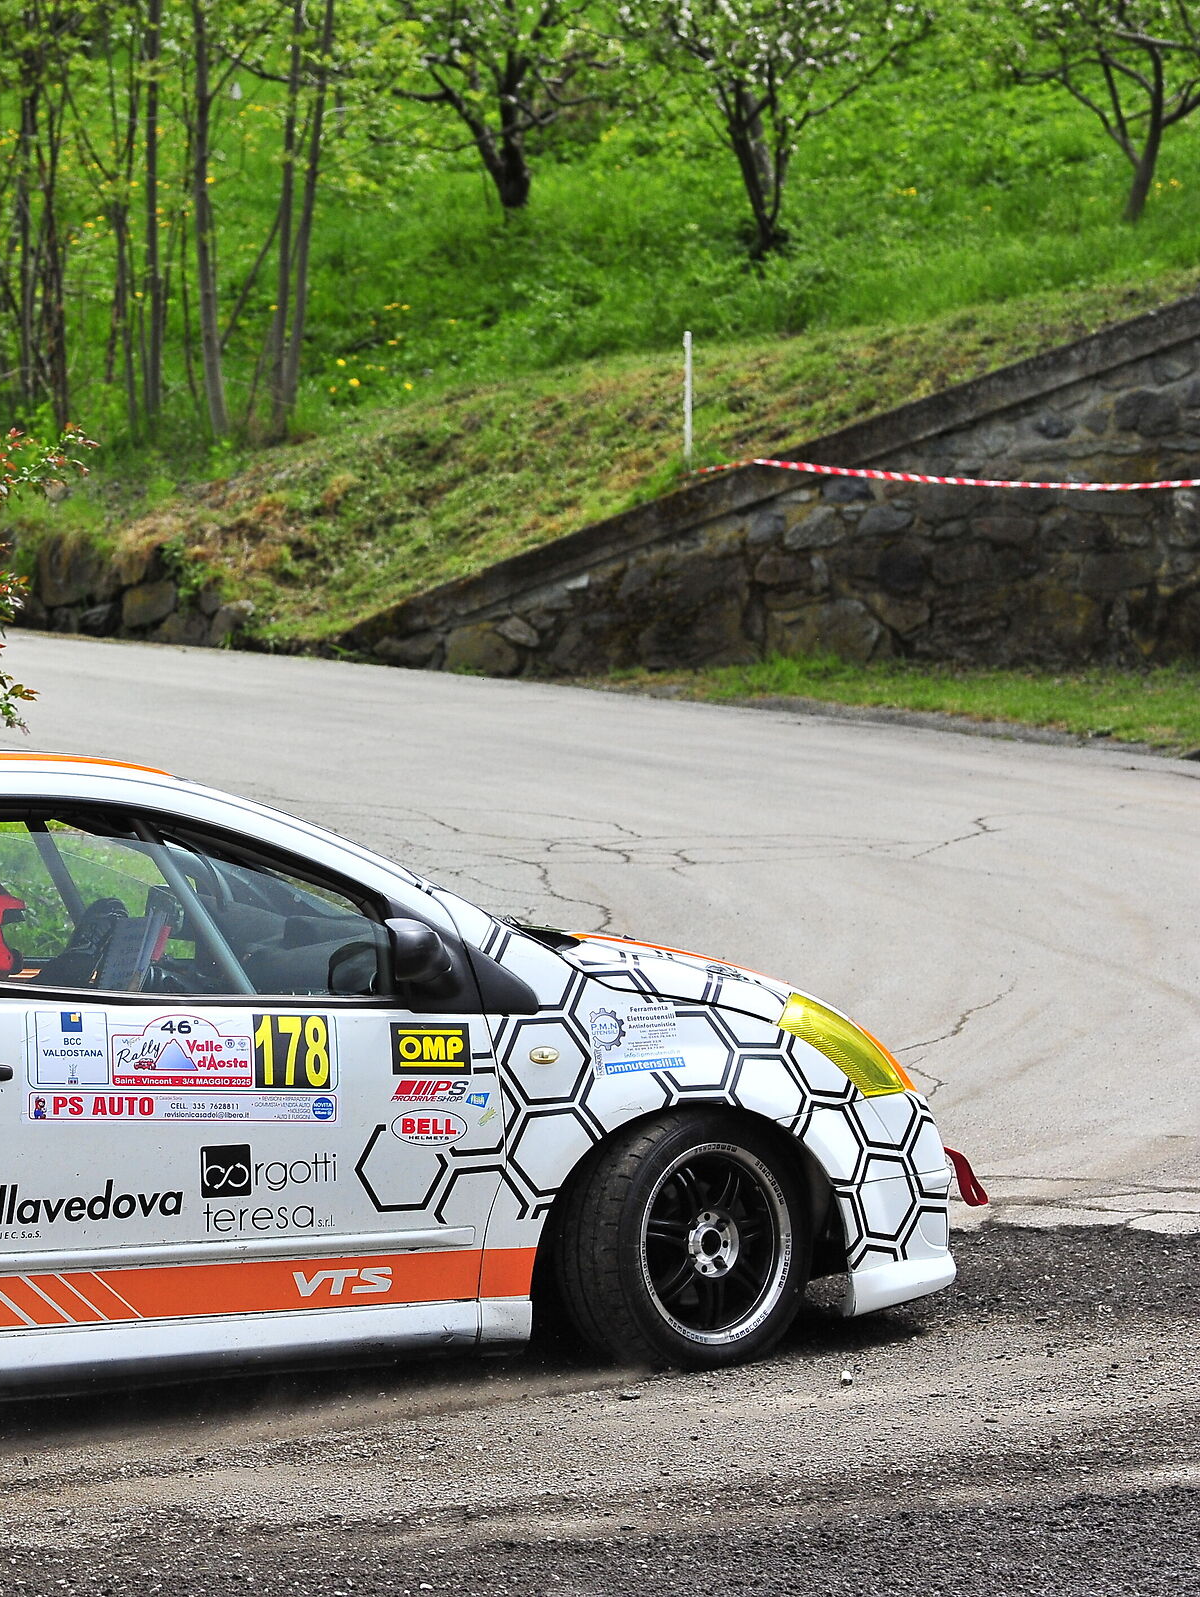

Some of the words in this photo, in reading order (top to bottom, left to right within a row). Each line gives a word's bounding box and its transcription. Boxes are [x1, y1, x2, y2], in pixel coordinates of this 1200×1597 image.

[626, 1013, 675, 1021] Elettroutensili
[63, 1037, 82, 1046] BCC
[185, 1039, 223, 1054] Valle
[399, 1038, 464, 1061] OMP
[43, 1048, 103, 1058] VALDOSTANA
[116, 1038, 161, 1067] Rally
[254, 1015, 331, 1088] 178
[197, 1053, 248, 1071] d'Aosta
[607, 1058, 684, 1074] pmnutensili.it
[182, 1078, 195, 1086] 3/4
[429, 1080, 470, 1096] PS
[53, 1096, 83, 1116] PS
[92, 1096, 154, 1116] AUTO
[192, 1102, 206, 1110] 335
[402, 1118, 457, 1135] BELL
[203, 1203, 314, 1232] teresa
[318, 1215, 336, 1228] s.r.l.
[4, 1232, 10, 1240] E
[10, 1231, 19, 1239] C.
[292, 1266, 393, 1297] VTS
